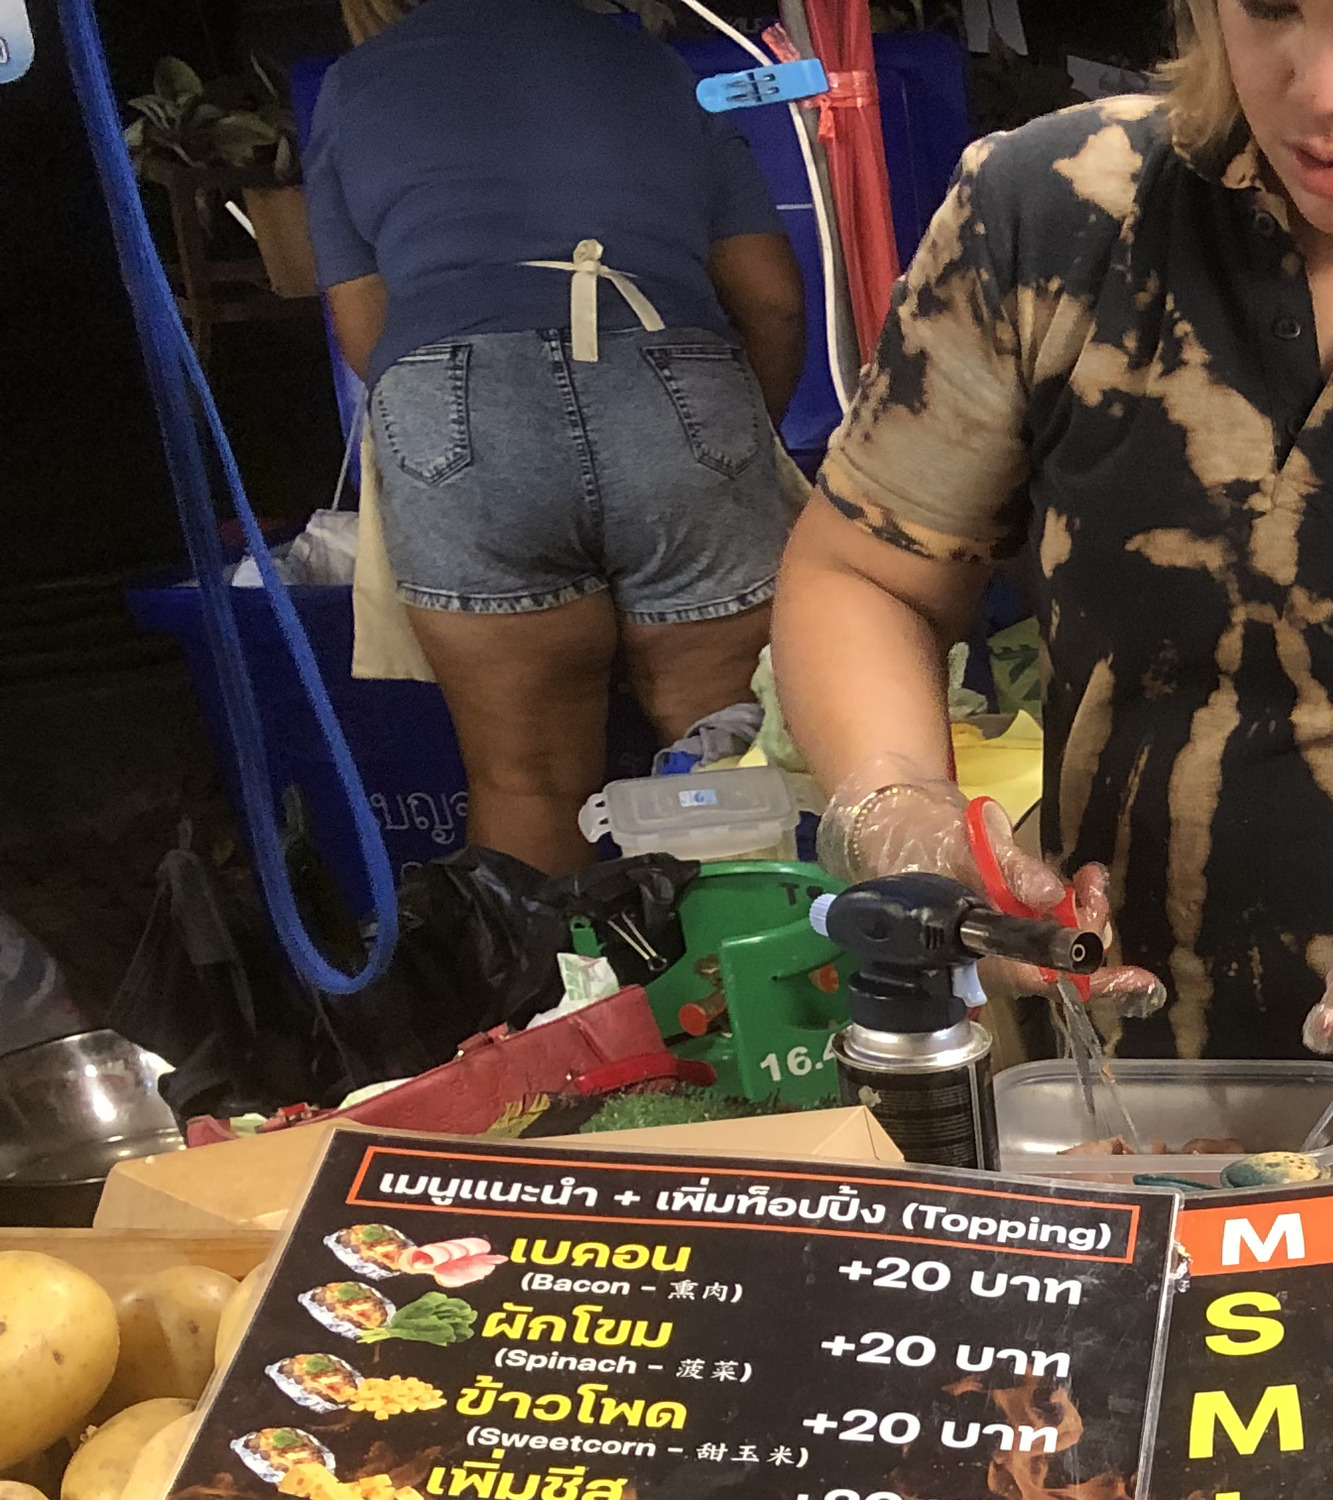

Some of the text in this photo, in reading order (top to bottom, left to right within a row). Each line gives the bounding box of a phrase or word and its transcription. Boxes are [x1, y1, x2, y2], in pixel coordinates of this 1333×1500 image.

[379, 1170, 599, 1208] เมนูแนะนำ
[655, 1177, 887, 1224] เพิ่มท็อปปิ้ง
[901, 1202, 1113, 1250] (Topping)
[509, 1236, 692, 1274] เบคอน
[520, 1272, 631, 1296] (Bacon
[837, 1257, 1083, 1306] +20 บาท
[480, 1301, 675, 1348] ผักโขม
[493, 1346, 637, 1375] (Spinach
[820, 1331, 1072, 1379] +20 บาท
[454, 1374, 689, 1431] ข้าวโพด
[465, 1425, 657, 1458] (Sweetcorn
[801, 1408, 1060, 1454] +20 บาท
